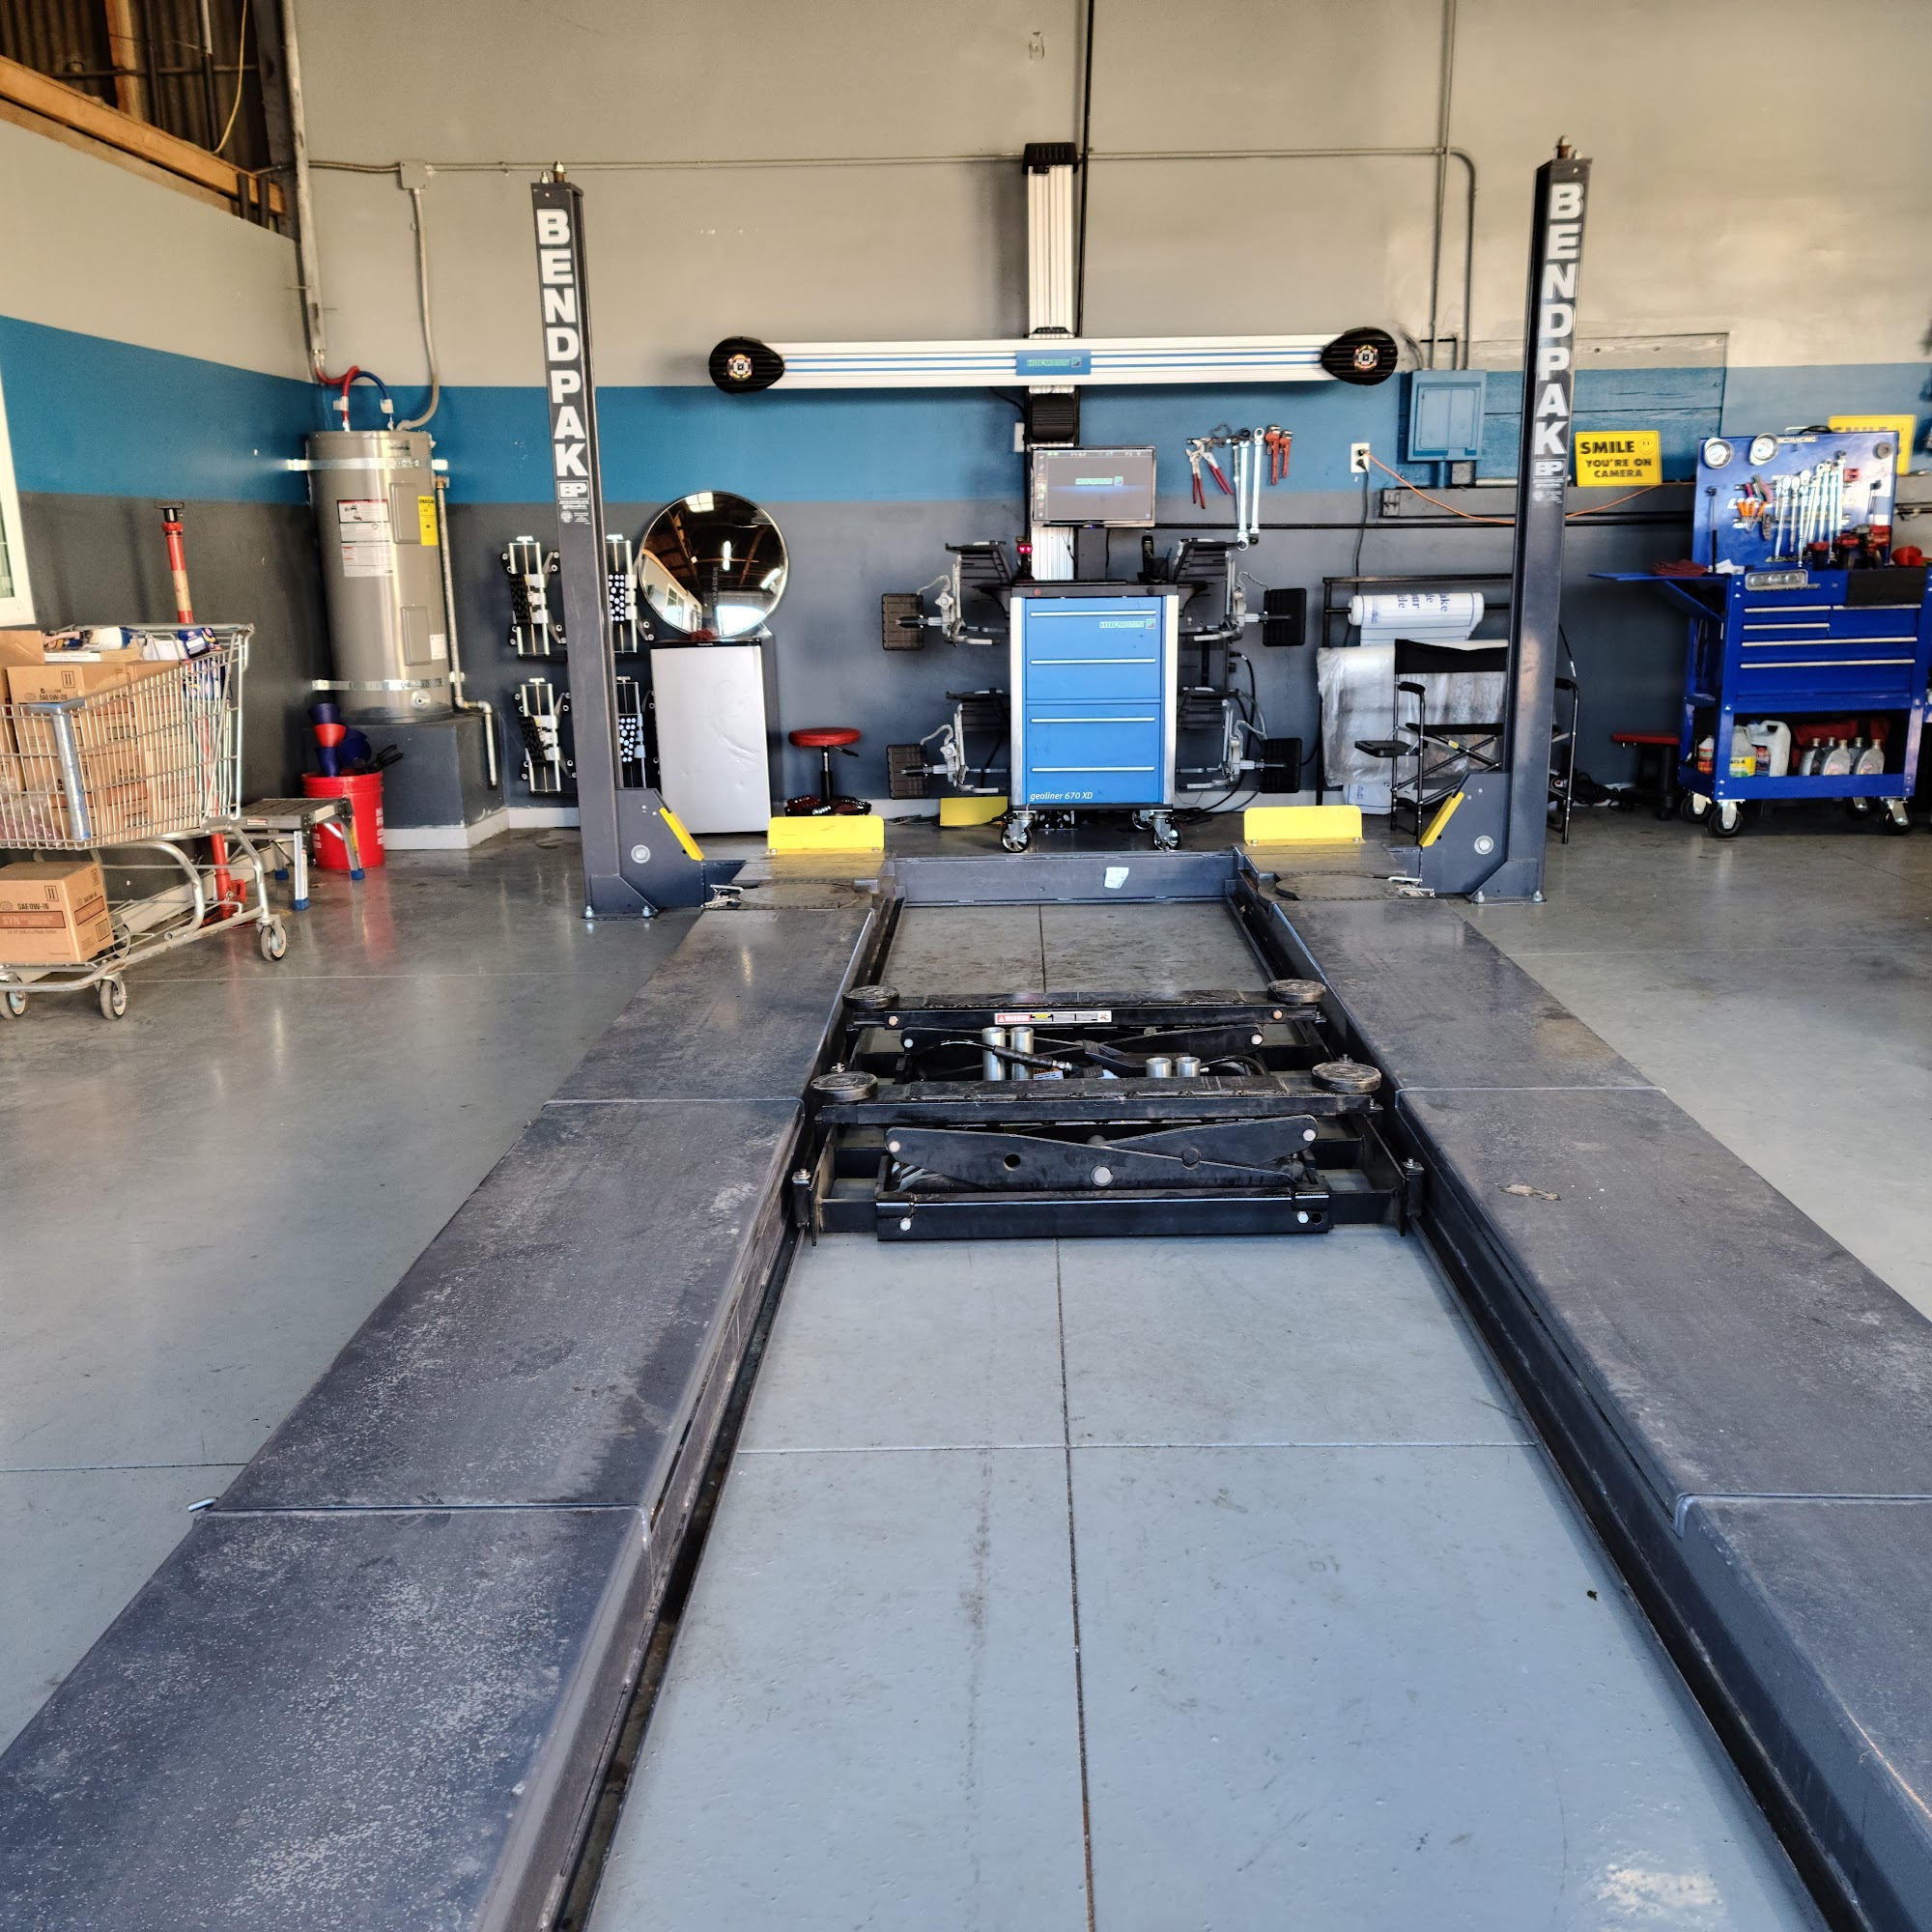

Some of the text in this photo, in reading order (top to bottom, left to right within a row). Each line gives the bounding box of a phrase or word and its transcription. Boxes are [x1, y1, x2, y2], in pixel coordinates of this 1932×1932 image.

[1535, 183, 1584, 455] BENDPAK
[537, 208, 588, 476] BENDPAK
[1580, 440, 1634, 454] SMILE
[1585, 458, 1652, 468] YOU'RE ON
[1030, 791, 1094, 802] geoliner 670 XD
